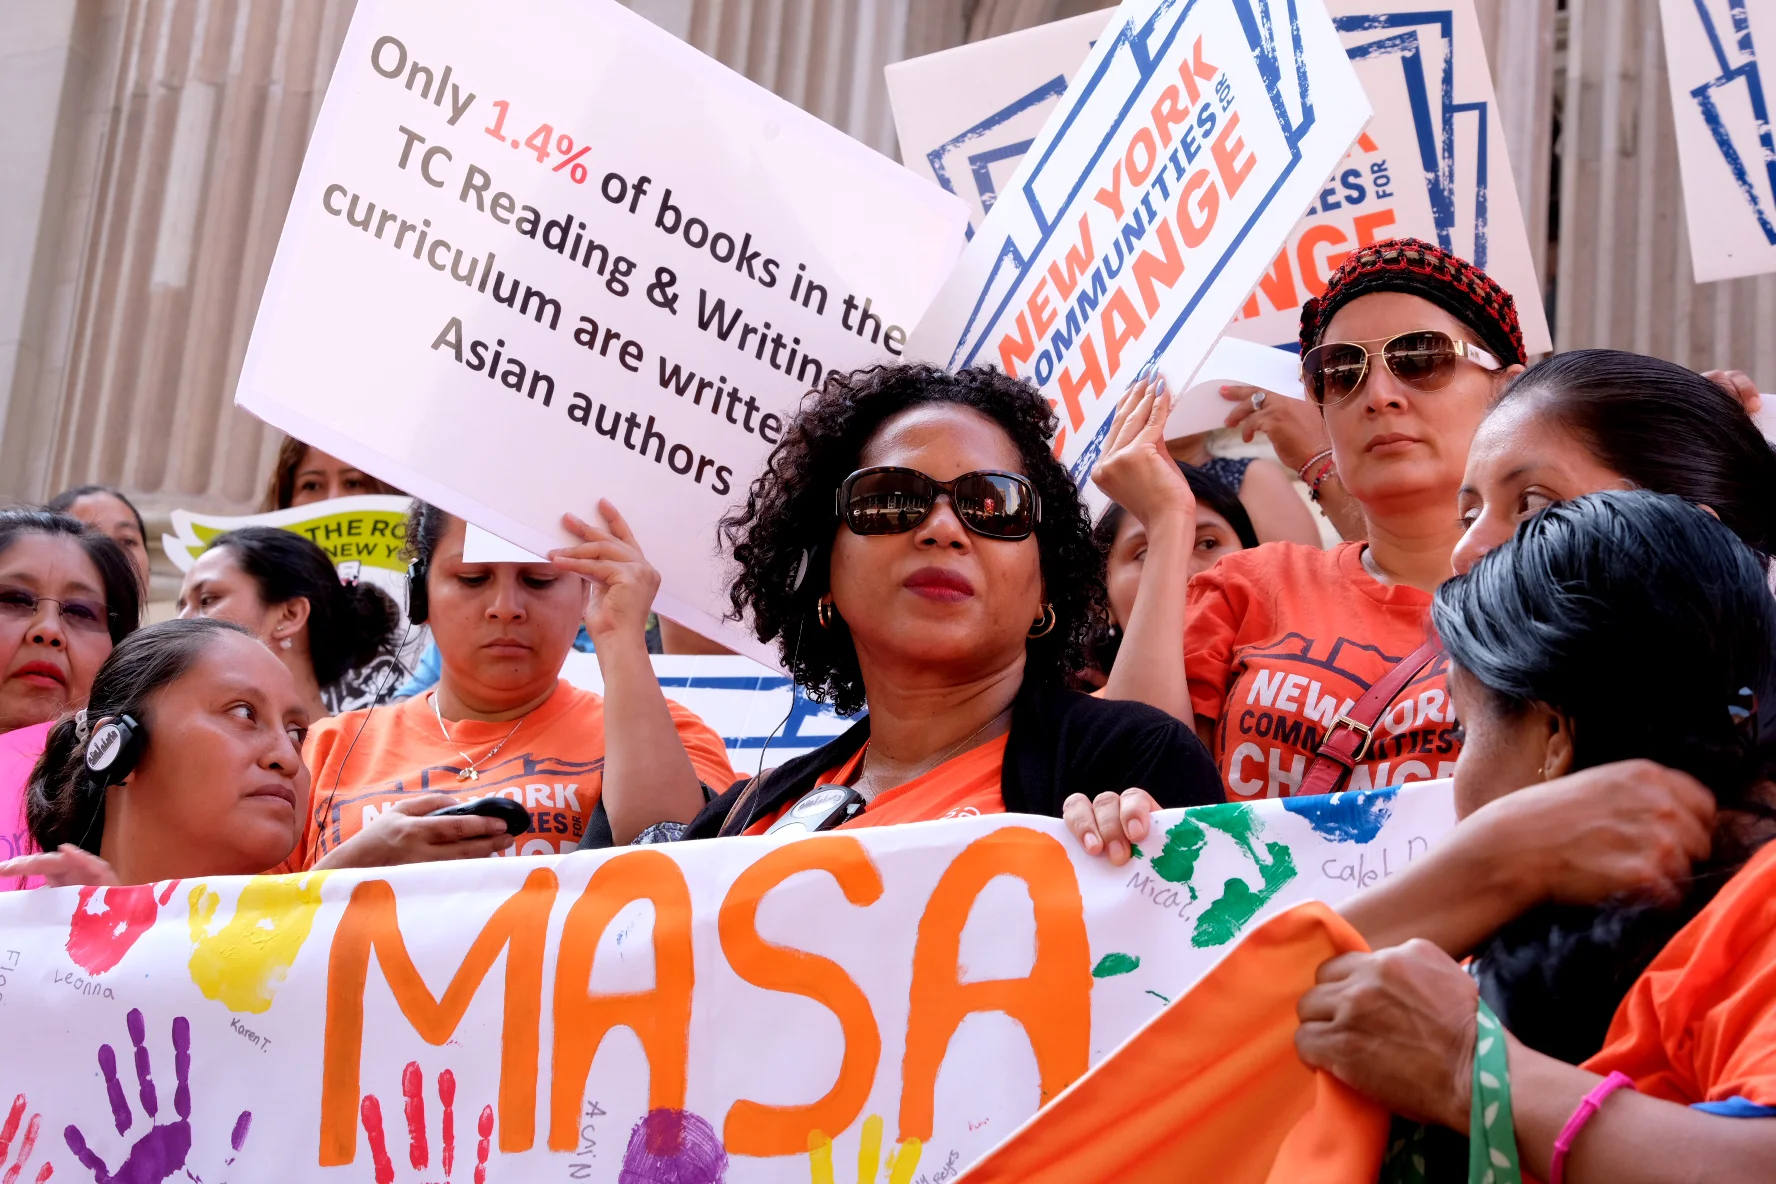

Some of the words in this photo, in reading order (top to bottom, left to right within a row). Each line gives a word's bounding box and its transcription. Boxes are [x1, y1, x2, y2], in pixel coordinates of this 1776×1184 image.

[1215, 72, 1235, 113] FOR
[371, 35, 476, 125] Only
[484, 99, 590, 185] 1.4%
[601, 170, 653, 215] of
[656, 189, 780, 290] books
[790, 263, 828, 316] in
[842, 294, 907, 356] the
[998, 212, 1096, 380] NEW
[1095, 34, 1219, 218] YORK
[1371, 159, 1394, 200] FOR
[398, 125, 453, 188] TC
[460, 163, 637, 297] Reading
[646, 266, 679, 316] &
[698, 288, 841, 388] Writin
[1033, 102, 1217, 387] OMMUNITIES
[323, 183, 562, 331] curriculum
[573, 315, 644, 373] are
[657, 355, 783, 445] writte
[431, 316, 556, 408] Asian
[567, 390, 734, 498] authors
[304, 519, 363, 541] THE
[323, 542, 378, 558] NEW
[1246, 669, 1355, 730] NEW
[571, 815, 583, 838] FOR
[53, 968, 115, 1000] Leonna
[318, 826, 1092, 1167] MASA
[230, 1017, 261, 1046] Karen
[260, 1037, 272, 1053] T.
